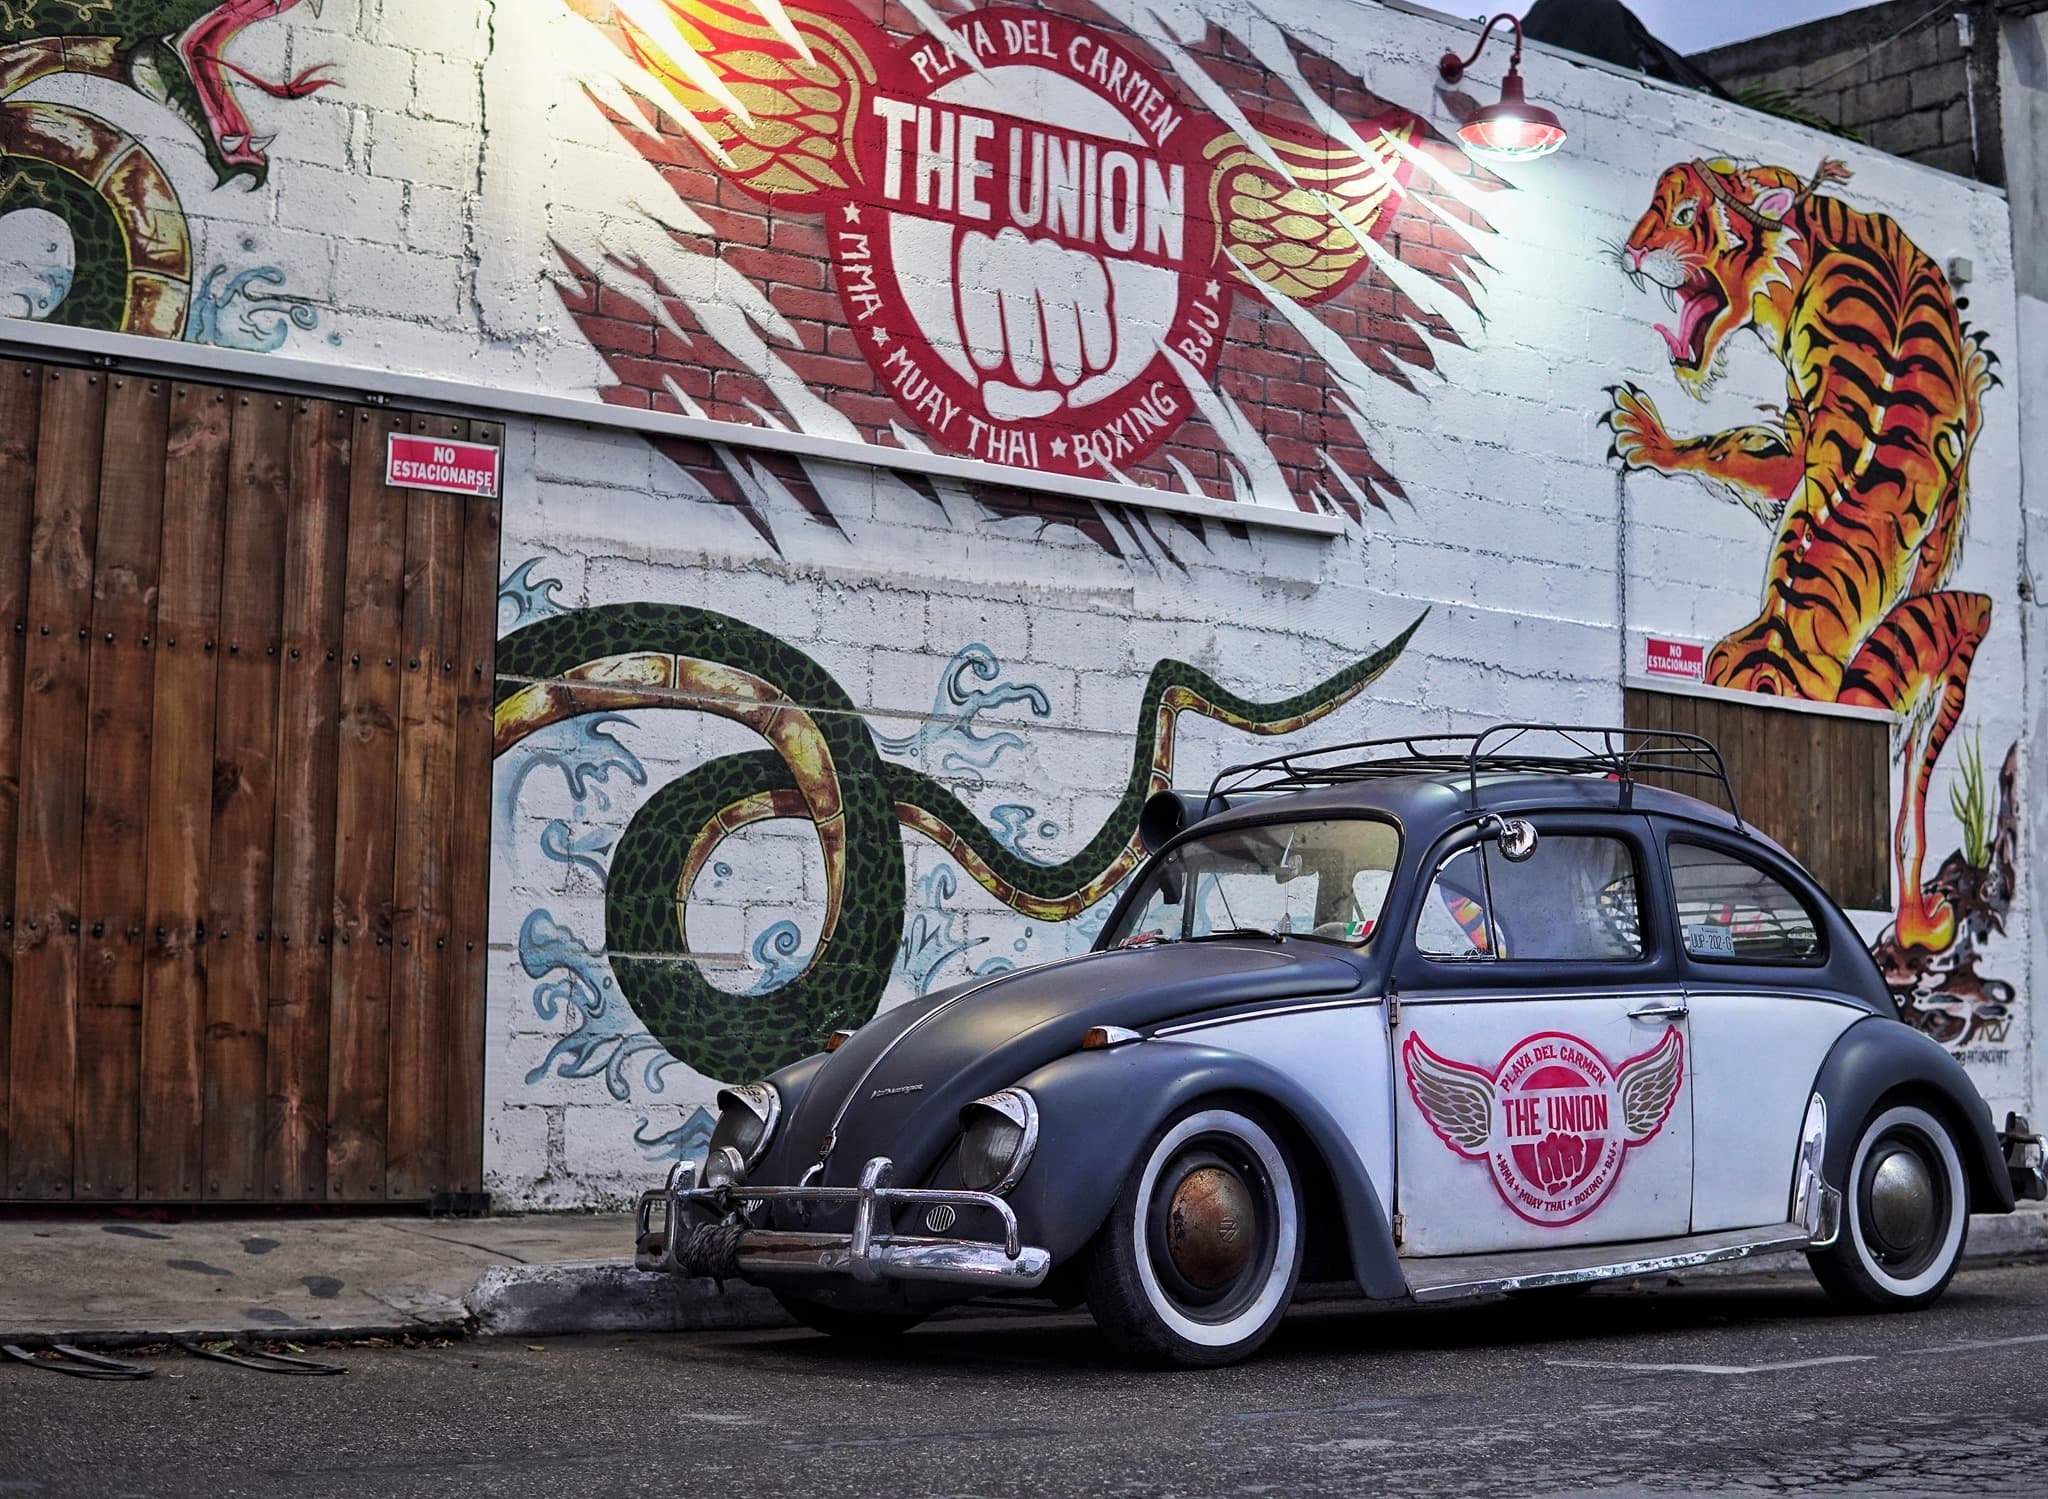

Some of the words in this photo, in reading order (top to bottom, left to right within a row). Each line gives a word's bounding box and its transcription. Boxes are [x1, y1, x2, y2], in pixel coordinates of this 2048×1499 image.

[910, 19, 998, 84] PLAYA
[1003, 19, 1057, 61] DEL
[1069, 36, 1181, 147] CARMEN
[873, 96, 995, 221] THE
[1008, 128, 1184, 261] UNION
[839, 232, 884, 321] MMA
[1179, 300, 1220, 369] BJJ
[883, 345, 960, 432] MUAY
[967, 414, 1039, 469] THAI
[1072, 381, 1179, 470] BOXING
[434, 446, 455, 463] NO
[393, 459, 492, 487] ESTACIONARSE
[1648, 655, 1702, 674] ESTACIONARSE
[1669, 644, 1682, 657] NO
[1500, 1053, 1534, 1093] PLAYA
[1533, 1045, 1557, 1062] DEL
[1560, 1046, 1606, 1088] CARMEN
[1502, 1097, 1542, 1137] THE
[1547, 1094, 1608, 1132] UNION
[1497, 1159, 1516, 1188] MMA
[1604, 1149, 1617, 1170] BJJ
[1518, 1189, 1543, 1210] MUAY
[1544, 1200, 1566, 1212] THAI
[1575, 1176, 1604, 1206] BOXING
